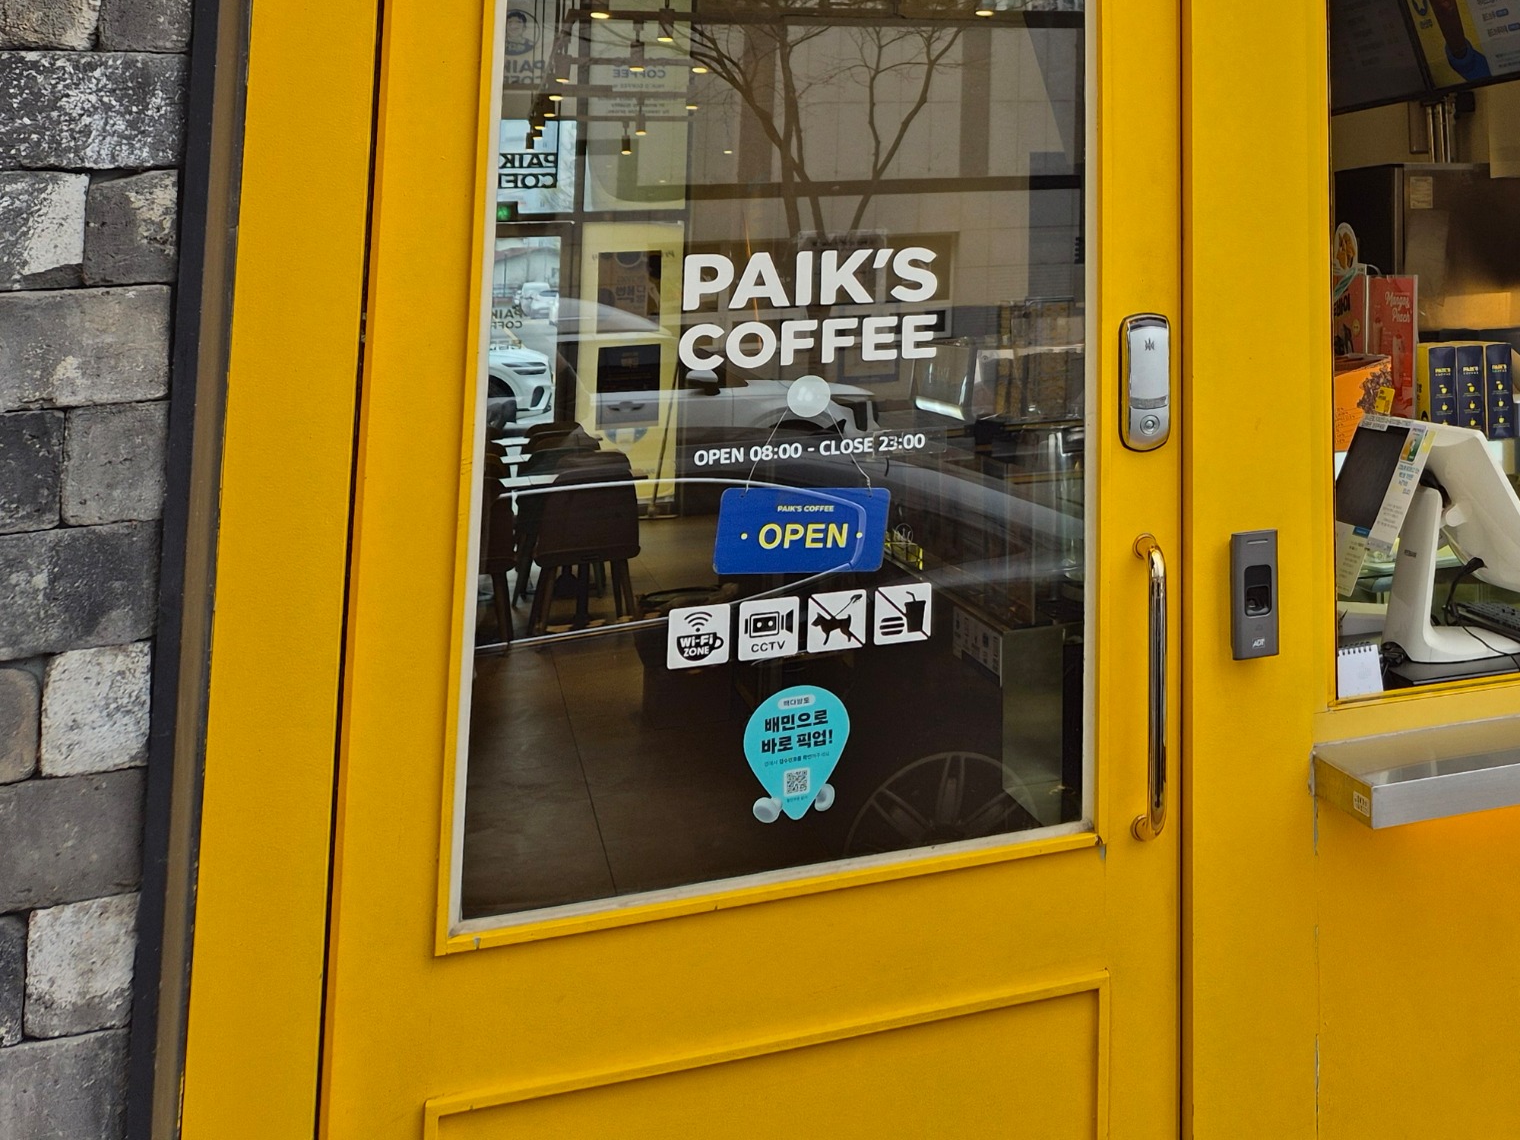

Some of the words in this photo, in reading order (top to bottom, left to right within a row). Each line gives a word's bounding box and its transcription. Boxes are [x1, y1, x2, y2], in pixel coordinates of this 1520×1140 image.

[683, 247, 938, 311] PAIK'S
[679, 315, 938, 371] COFFEE
[694, 447, 744, 466] OPEN
[750, 443, 802, 461] 08:00
[819, 438, 873, 456] CLOSE
[878, 433, 926, 452] 23:00
[777, 505, 802, 513] PAIK'S
[804, 505, 835, 513] COFFEE
[758, 523, 849, 550] OPEN
[680, 635, 714, 648] Wi-Fi
[683, 645, 710, 657] ZONE
[751, 640, 786, 653] CCTV
[764, 709, 829, 733] 배민으로
[761, 735, 793, 754] 바로
[796, 729, 833, 748] 픽업!
